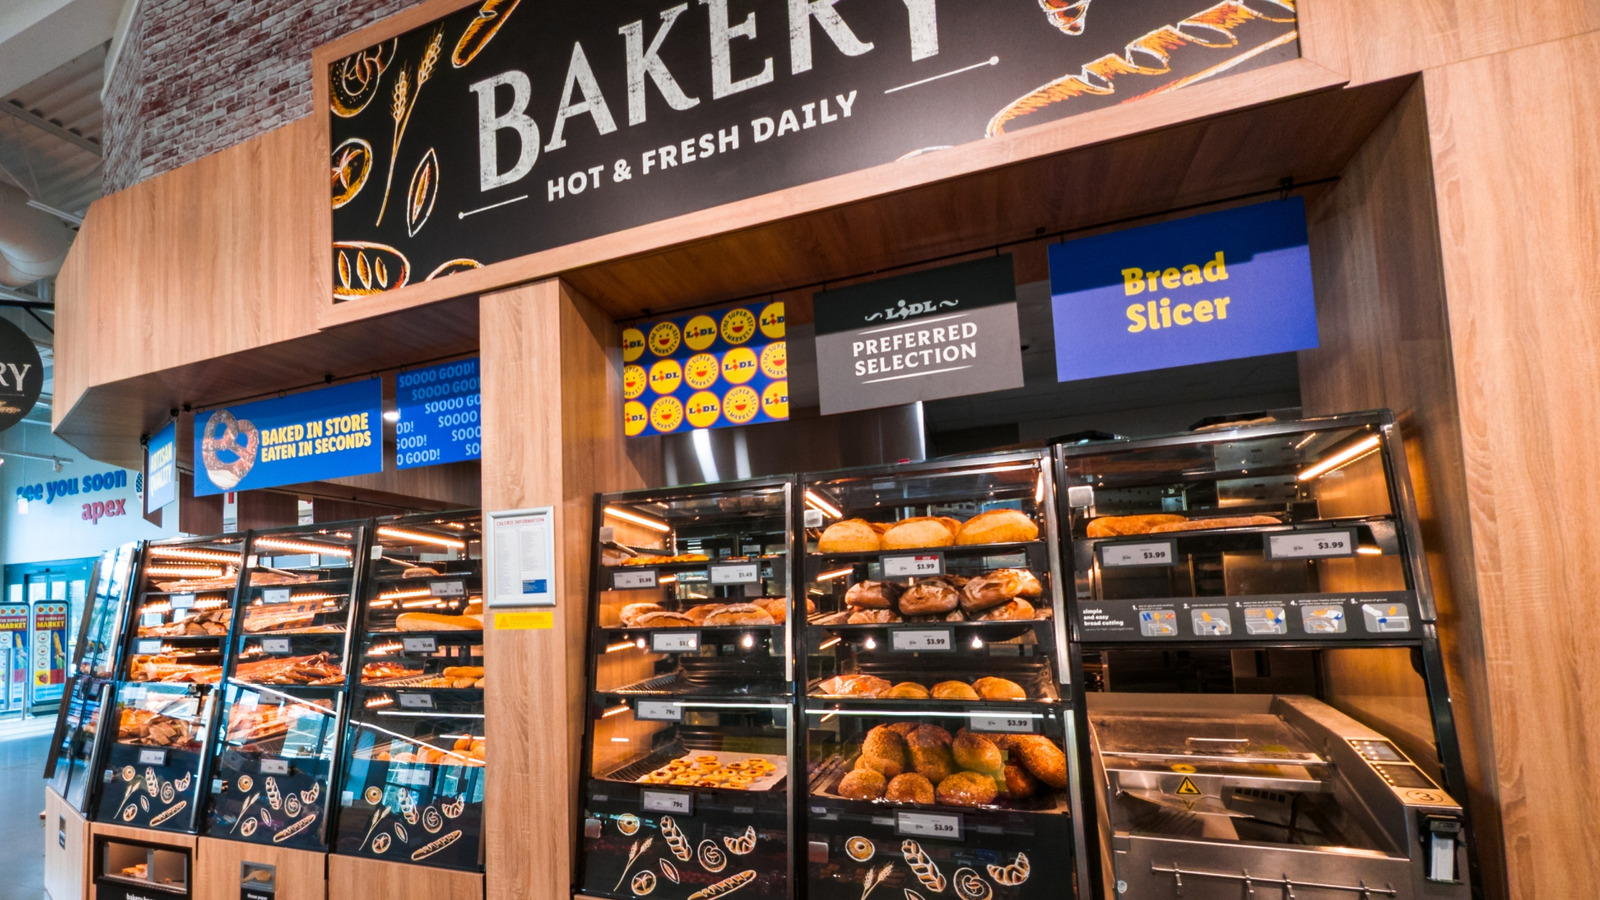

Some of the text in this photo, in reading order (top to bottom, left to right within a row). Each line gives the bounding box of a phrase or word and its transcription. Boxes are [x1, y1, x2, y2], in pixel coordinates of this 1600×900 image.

[469, 0, 939, 192] BAKERY
[547, 90, 858, 202] HOT & FRESH DAILY
[1121, 250, 1229, 296] Bread
[1126, 296, 1230, 333] Slicer
[654, 343, 676, 355] MARKET
[726, 331, 750, 343] MARKET
[852, 322, 978, 357] PREFERRED
[855, 342, 977, 376] SELECTION
[400, 362, 475, 388] SOOOO GOOD!
[412, 384, 450, 400] SOOOO
[425, 396, 464, 414] SOOOO
[262, 412, 368, 446] BAKED IN STORE
[438, 410, 478, 428] SOOOO
[262, 430, 372, 462] EATEN IN SECONDS
[406, 448, 440, 464] GOOD!
[16, 470, 126, 504] see you soon
[82, 498, 126, 525] apex
[1144, 551, 1166, 560] $3.99
[1318, 541, 1344, 550] $3.99
